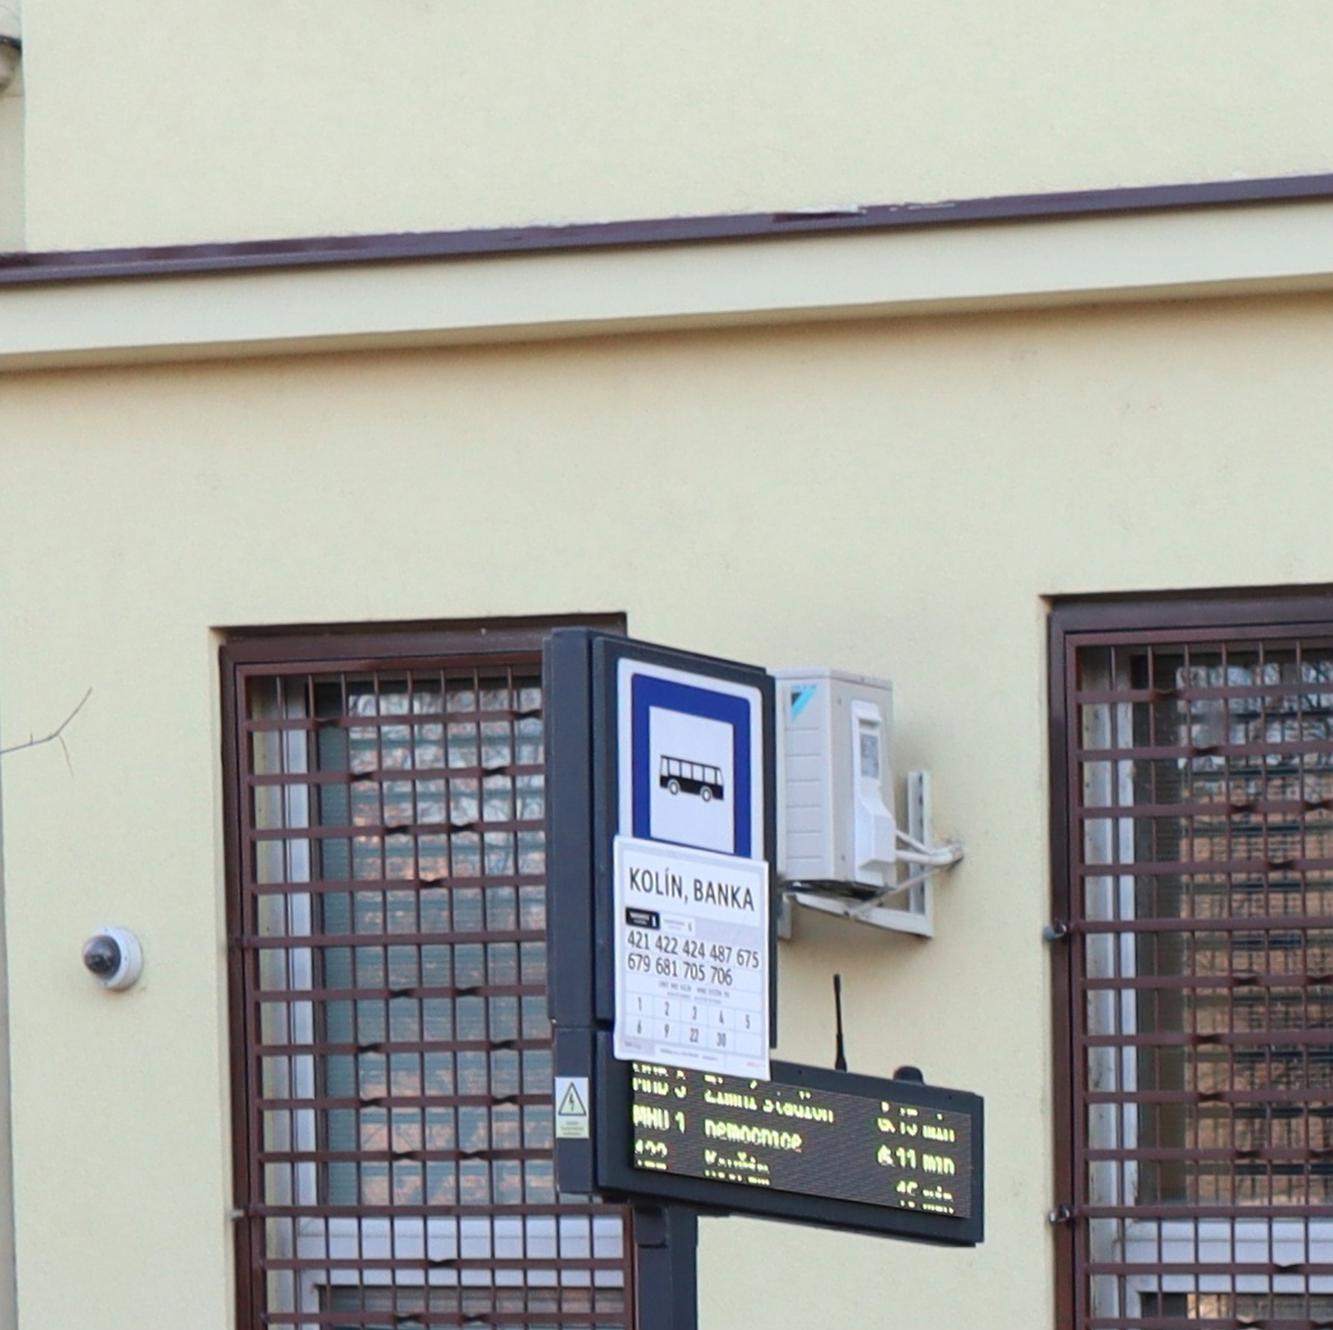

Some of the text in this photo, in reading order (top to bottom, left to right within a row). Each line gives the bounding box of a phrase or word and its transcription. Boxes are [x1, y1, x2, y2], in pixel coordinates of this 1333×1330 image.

[629, 866, 755, 912] KOLÍN, BANKA
[627, 930, 760, 969] 421 422 424 487 675
[627, 952, 733, 987] 679 681 705 706
[637, 996, 751, 1029] 1 2 3 4 5
[664, 1023, 669, 1038] 9
[689, 1027, 699, 1044] 22
[716, 1033, 728, 1048] 30
